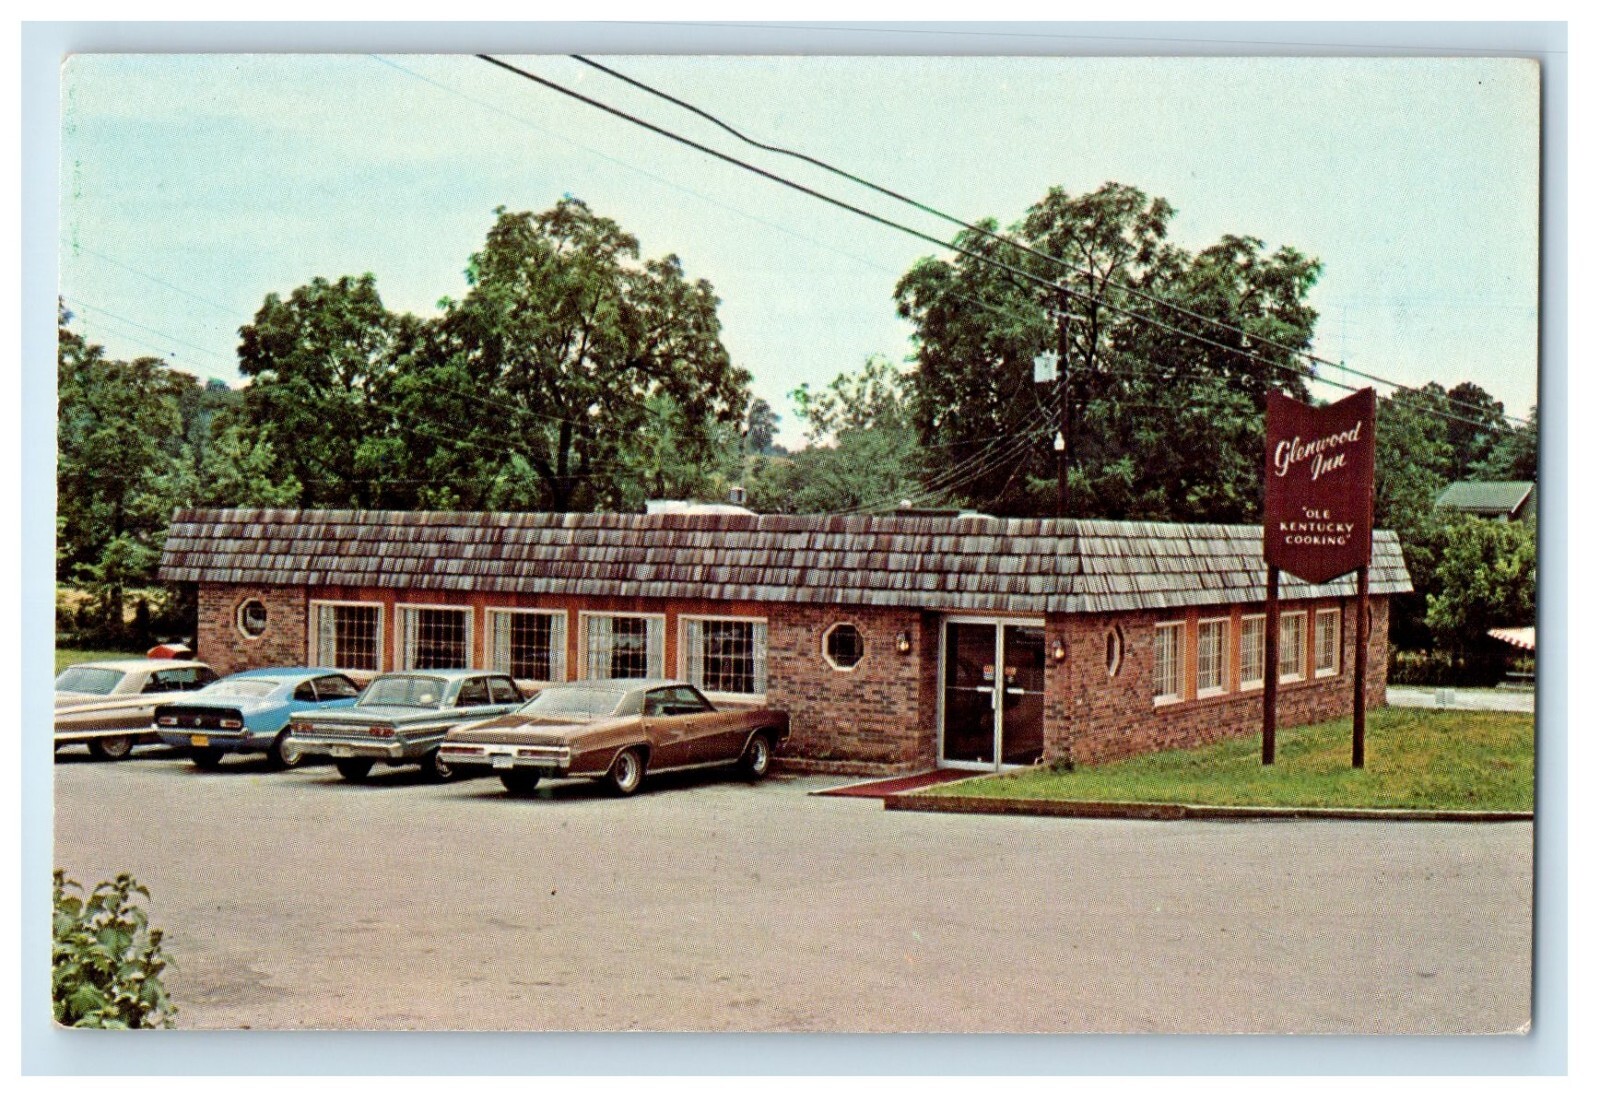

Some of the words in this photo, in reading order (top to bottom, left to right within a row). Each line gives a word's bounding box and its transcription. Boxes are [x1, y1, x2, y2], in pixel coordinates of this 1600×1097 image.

[1275, 420, 1361, 477] Glenwood
[1311, 453, 1346, 480] Inn
[1279, 522, 1354, 532] KENTUCKY
